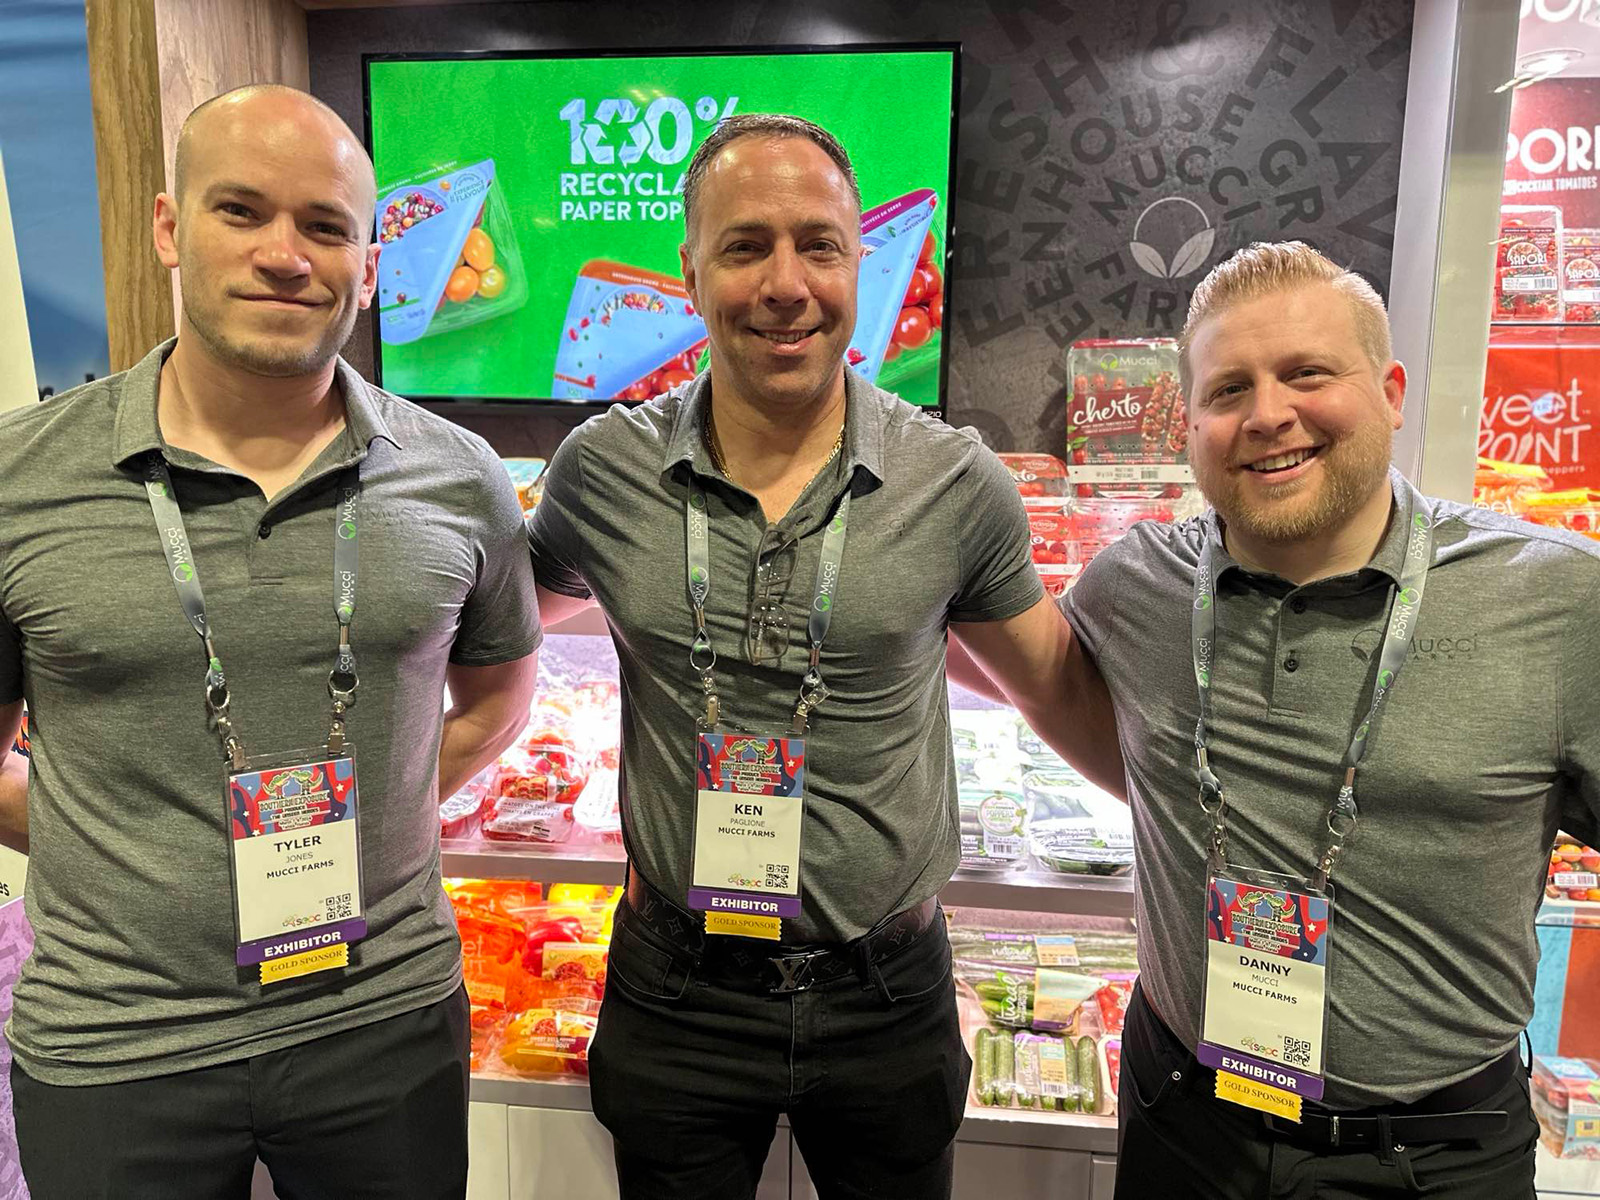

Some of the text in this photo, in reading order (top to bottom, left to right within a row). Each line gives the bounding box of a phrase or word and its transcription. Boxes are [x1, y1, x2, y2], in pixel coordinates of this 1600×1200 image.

[1089, 146, 1262, 227] MUCCI
[561, 202, 632, 221] PAPER
[1120, 355, 1158, 366] Mucci
[1073, 392, 1142, 425] cherto
[164, 527, 187, 564] Mucci
[1413, 527, 1428, 560] Mucci
[340, 570, 351, 606] Mucci
[820, 561, 835, 595] Mucci
[1394, 604, 1413, 641] Mucci
[1199, 637, 1208, 672] Mucci
[734, 804, 763, 816] KEN
[718, 827, 776, 838] MUCCI FARMS
[730, 818, 766, 828] PAGLIONE
[274, 835, 322, 852] TYLER
[266, 859, 334, 879] MUCCI FARMS
[286, 852, 313, 864] JONES
[711, 897, 778, 912] EXHIBITOR
[713, 917, 777, 931] GOLD SPONSOR
[264, 931, 341, 957] EXHIBITOR
[270, 949, 343, 973] GOLD SPONSOR
[1239, 954, 1291, 977] DANNY
[1251, 974, 1279, 987] MUCCI
[1233, 981, 1298, 1005] MUCCI FARMS
[1221, 1056, 1297, 1089] EXHIBITOR
[1224, 1079, 1296, 1109] GOLD SPONSOR
